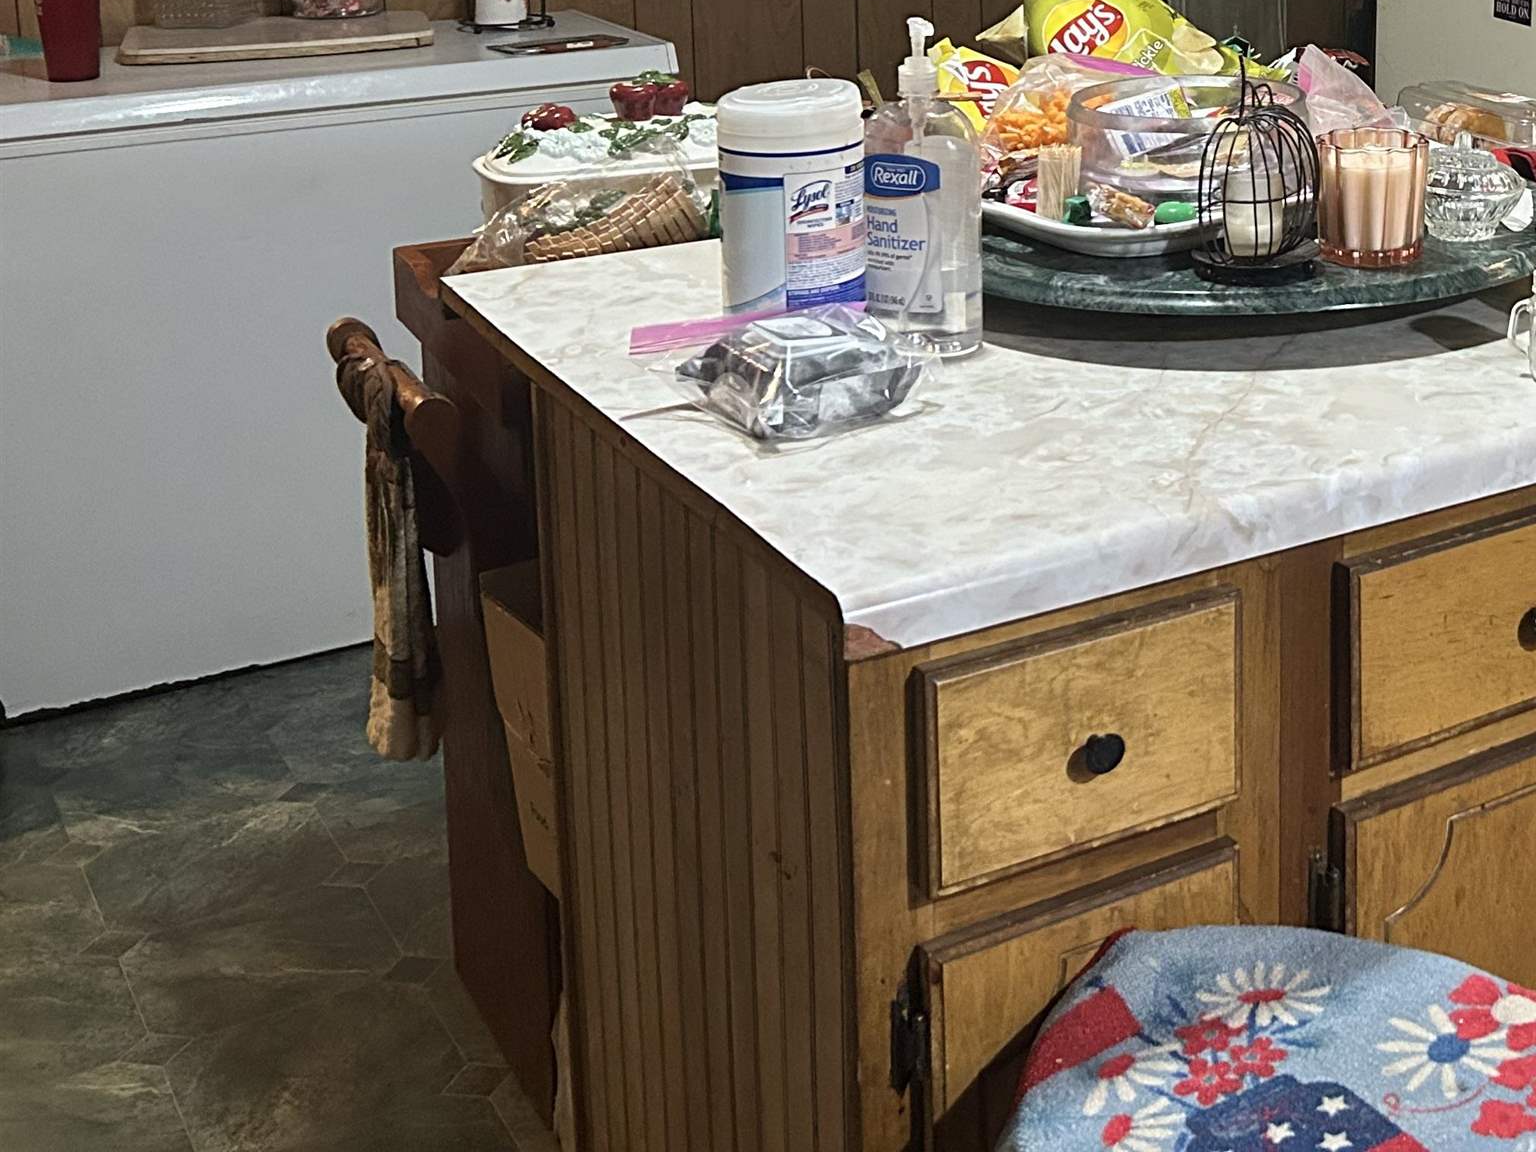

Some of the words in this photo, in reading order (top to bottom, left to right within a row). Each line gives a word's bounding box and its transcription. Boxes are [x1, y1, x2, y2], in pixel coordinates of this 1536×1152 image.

[1495, 0, 1517, 15] HOLD
[1518, 6, 1530, 20] ON
[1132, 39, 1164, 69] ickle
[874, 166, 918, 185] Rexall
[791, 183, 829, 211] Lysol
[866, 215, 898, 233] Hand
[866, 232, 926, 251] Sanitizer
